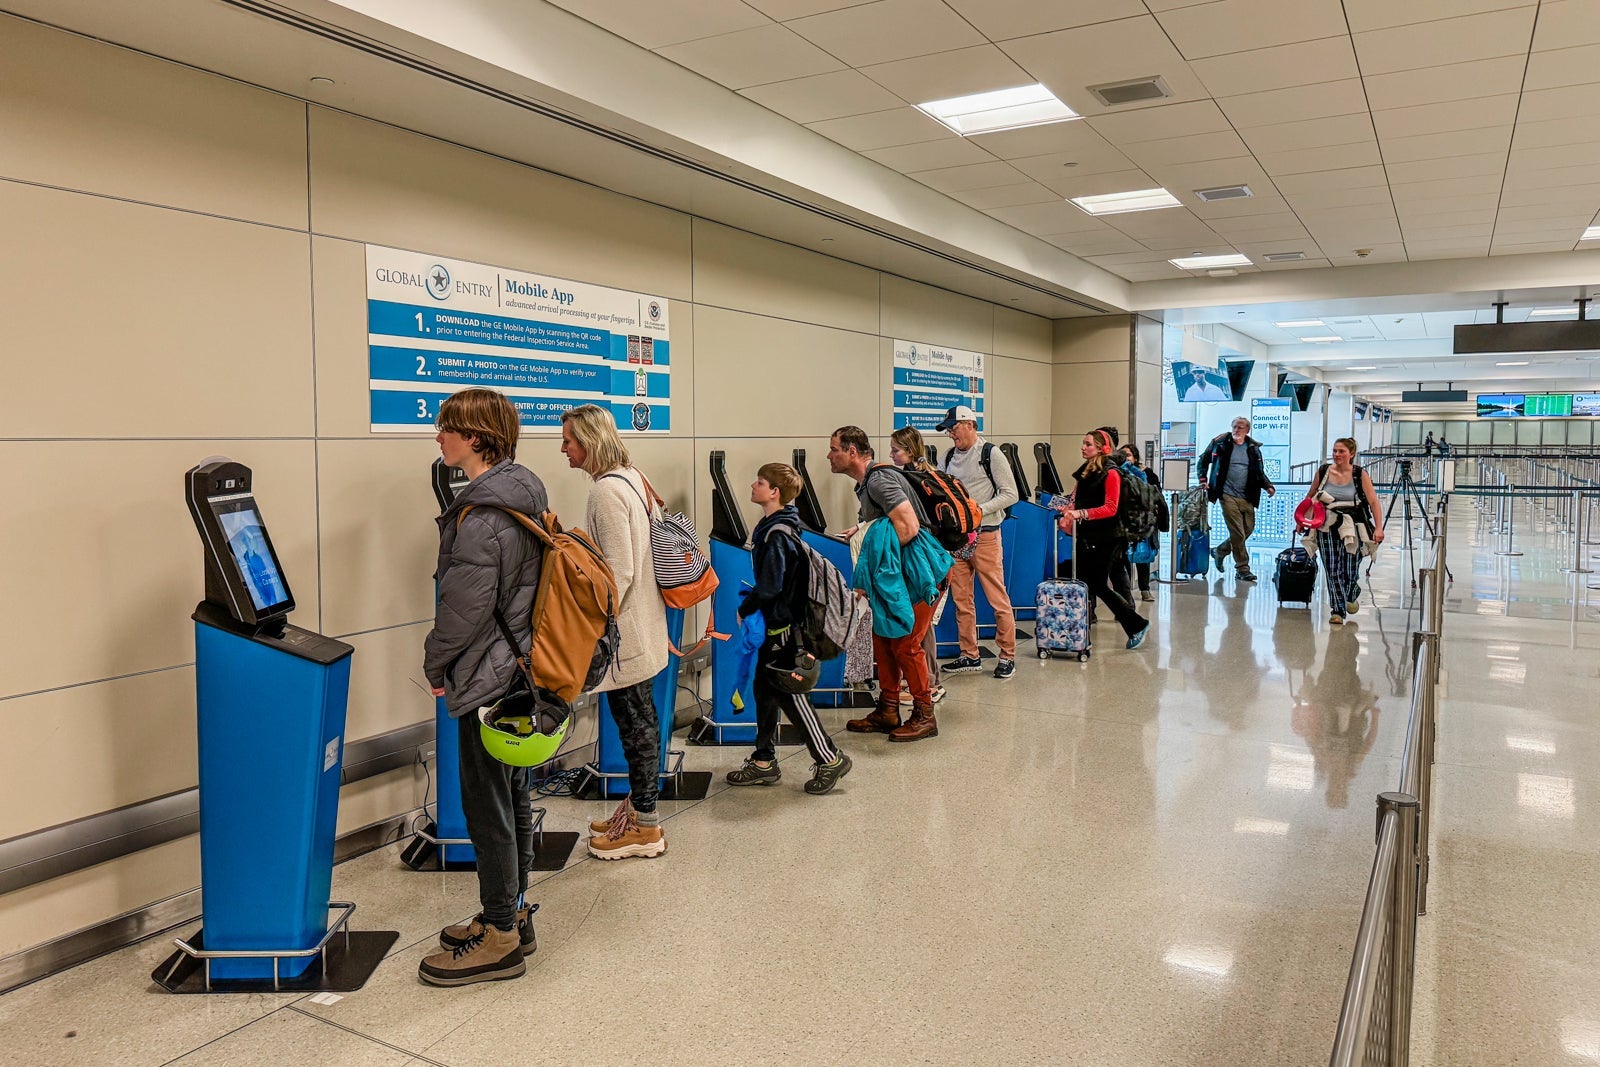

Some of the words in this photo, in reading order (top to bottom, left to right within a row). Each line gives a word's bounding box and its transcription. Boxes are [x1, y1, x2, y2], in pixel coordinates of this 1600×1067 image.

[376, 268, 424, 288] GLOBAL
[456, 280, 493, 298] ENTRY
[505, 279, 548, 299] Mobile
[551, 287, 575, 305] App
[505, 298, 537, 311] advanced
[537, 304, 559, 314] arrival
[560, 308, 590, 320] processing
[610, 313, 635, 325] fingertips
[415, 312, 431, 333] 1.
[436, 314, 480, 327] DOWNLOAD
[481, 320, 492, 329] the
[493, 321, 502, 329] GE
[503, 323, 524, 332] Mobile
[525, 325, 537, 334] App
[538, 327, 545, 336] by
[546, 328, 570, 339] scanning
[571, 331, 580, 339] the
[580, 332, 589, 340] QR
[436, 326, 453, 336] prior
[454, 328, 462, 336] to
[463, 329, 491, 340] entering
[492, 331, 503, 340] the
[503, 333, 526, 343] Federal
[526, 336, 556, 346] Inspection
[556, 339, 575, 348] Service
[575, 341, 589, 349] Area.
[416, 355, 432, 376] 2.
[437, 357, 466, 368] SUBMIT
[467, 360, 474, 368] A
[474, 360, 498, 369] PHOTO
[519, 364, 528, 372] GE
[529, 365, 549, 374] Mobile
[550, 366, 562, 375] App
[562, 368, 569, 376] to
[569, 369, 584, 377] verify
[438, 369, 479, 380] membership
[480, 372, 493, 380] and
[493, 372, 513, 381] arrival
[514, 374, 526, 382] into
[527, 375, 537, 383] the
[417, 398, 433, 419] 3.
[514, 402, 535, 410] ENTRY
[536, 403, 548, 411] CBP
[549, 403, 573, 411] OFFICER
[532, 414, 546, 422] your
